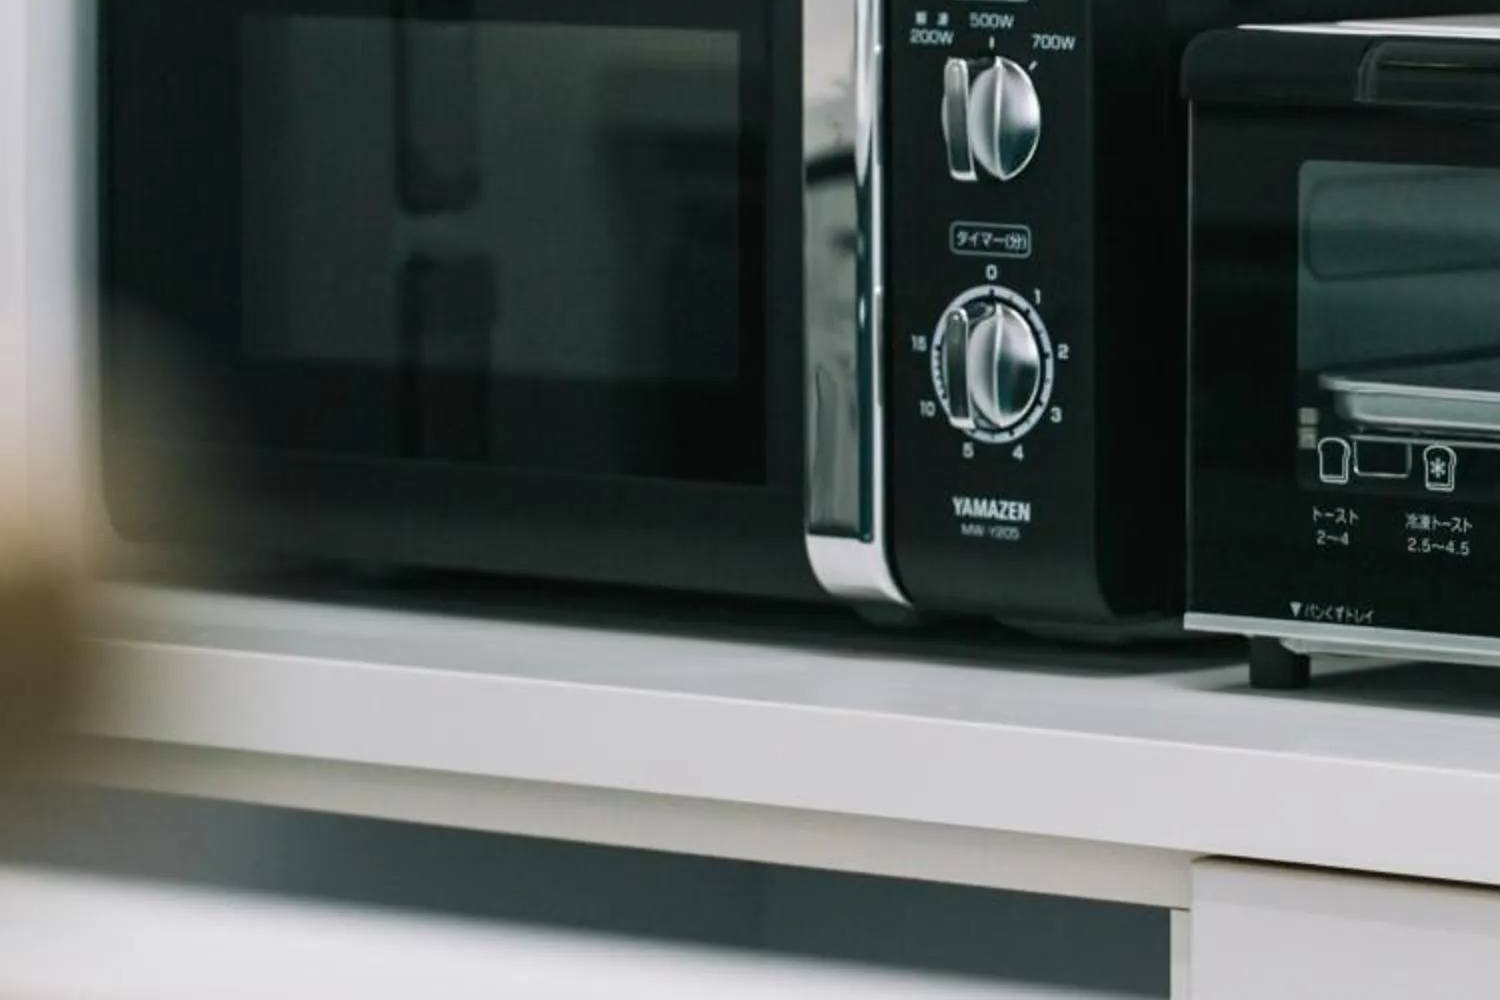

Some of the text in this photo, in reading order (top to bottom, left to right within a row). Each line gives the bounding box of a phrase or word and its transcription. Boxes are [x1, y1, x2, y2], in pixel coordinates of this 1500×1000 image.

[969, 12, 1015, 29] 500W
[909, 28, 955, 45] 200W
[1031, 33, 1077, 50] 700W
[985, 263, 999, 281] 0
[1033, 288, 1041, 305] 1
[1057, 343, 1069, 360] 2
[919, 400, 936, 418] 10
[1050, 406, 1062, 424] 3
[1012, 443, 1024, 461] 4
[952, 496, 1031, 522] YAMAZEN
[1312, 505, 1360, 525] トースト
